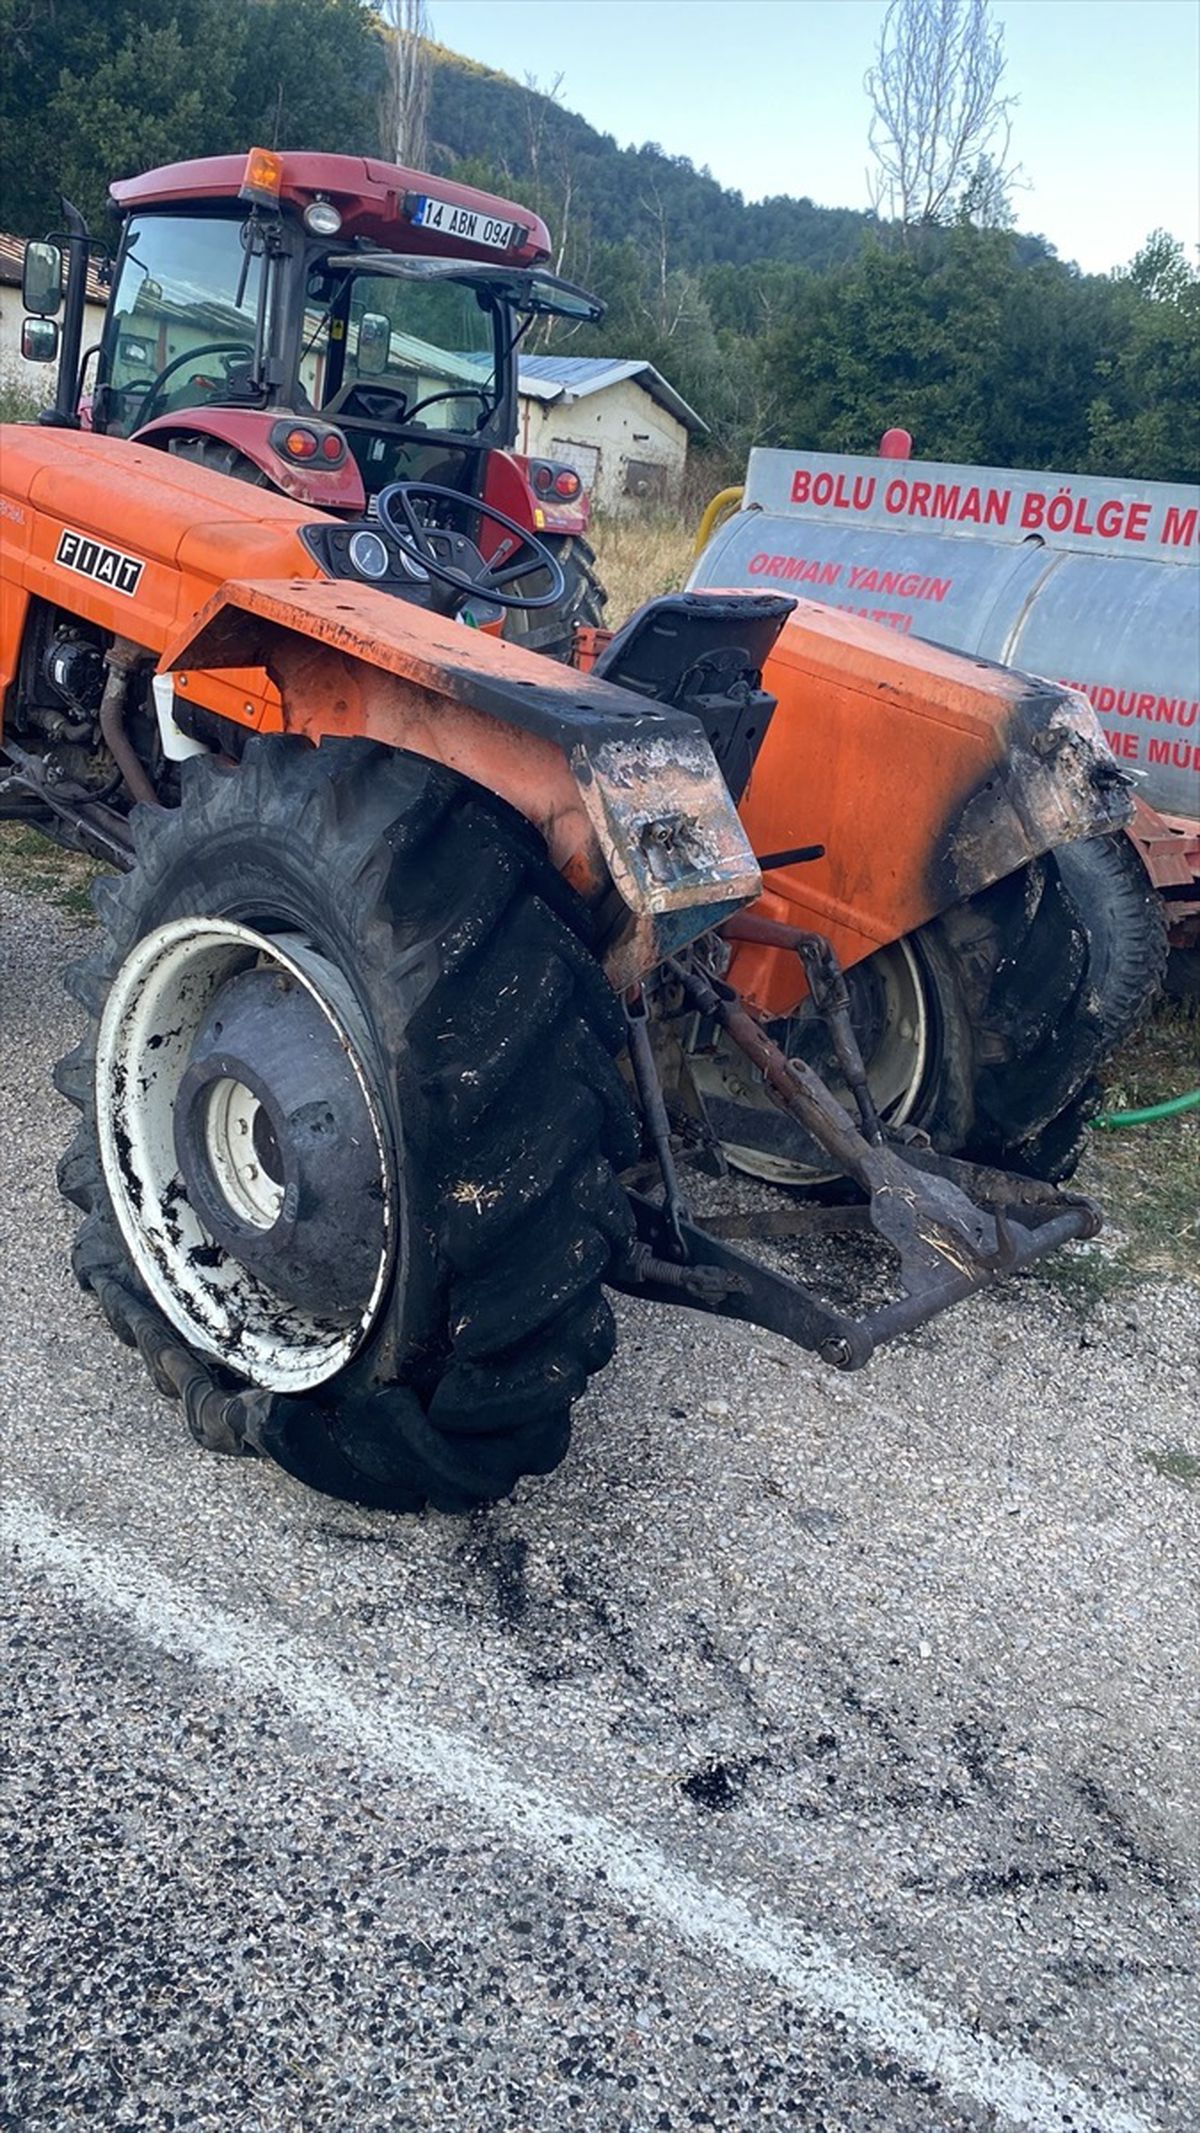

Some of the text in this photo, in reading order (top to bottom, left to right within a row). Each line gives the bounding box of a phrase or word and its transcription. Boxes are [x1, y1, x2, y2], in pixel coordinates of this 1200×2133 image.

[425, 202, 511, 246] 14 ABN 094
[791, 470, 1200, 546] BOLU ORMAN BÖLGE M
[61, 537, 139, 587] FIAT
[748, 552, 842, 585] ORMAN
[848, 565, 952, 601] YANGIN
